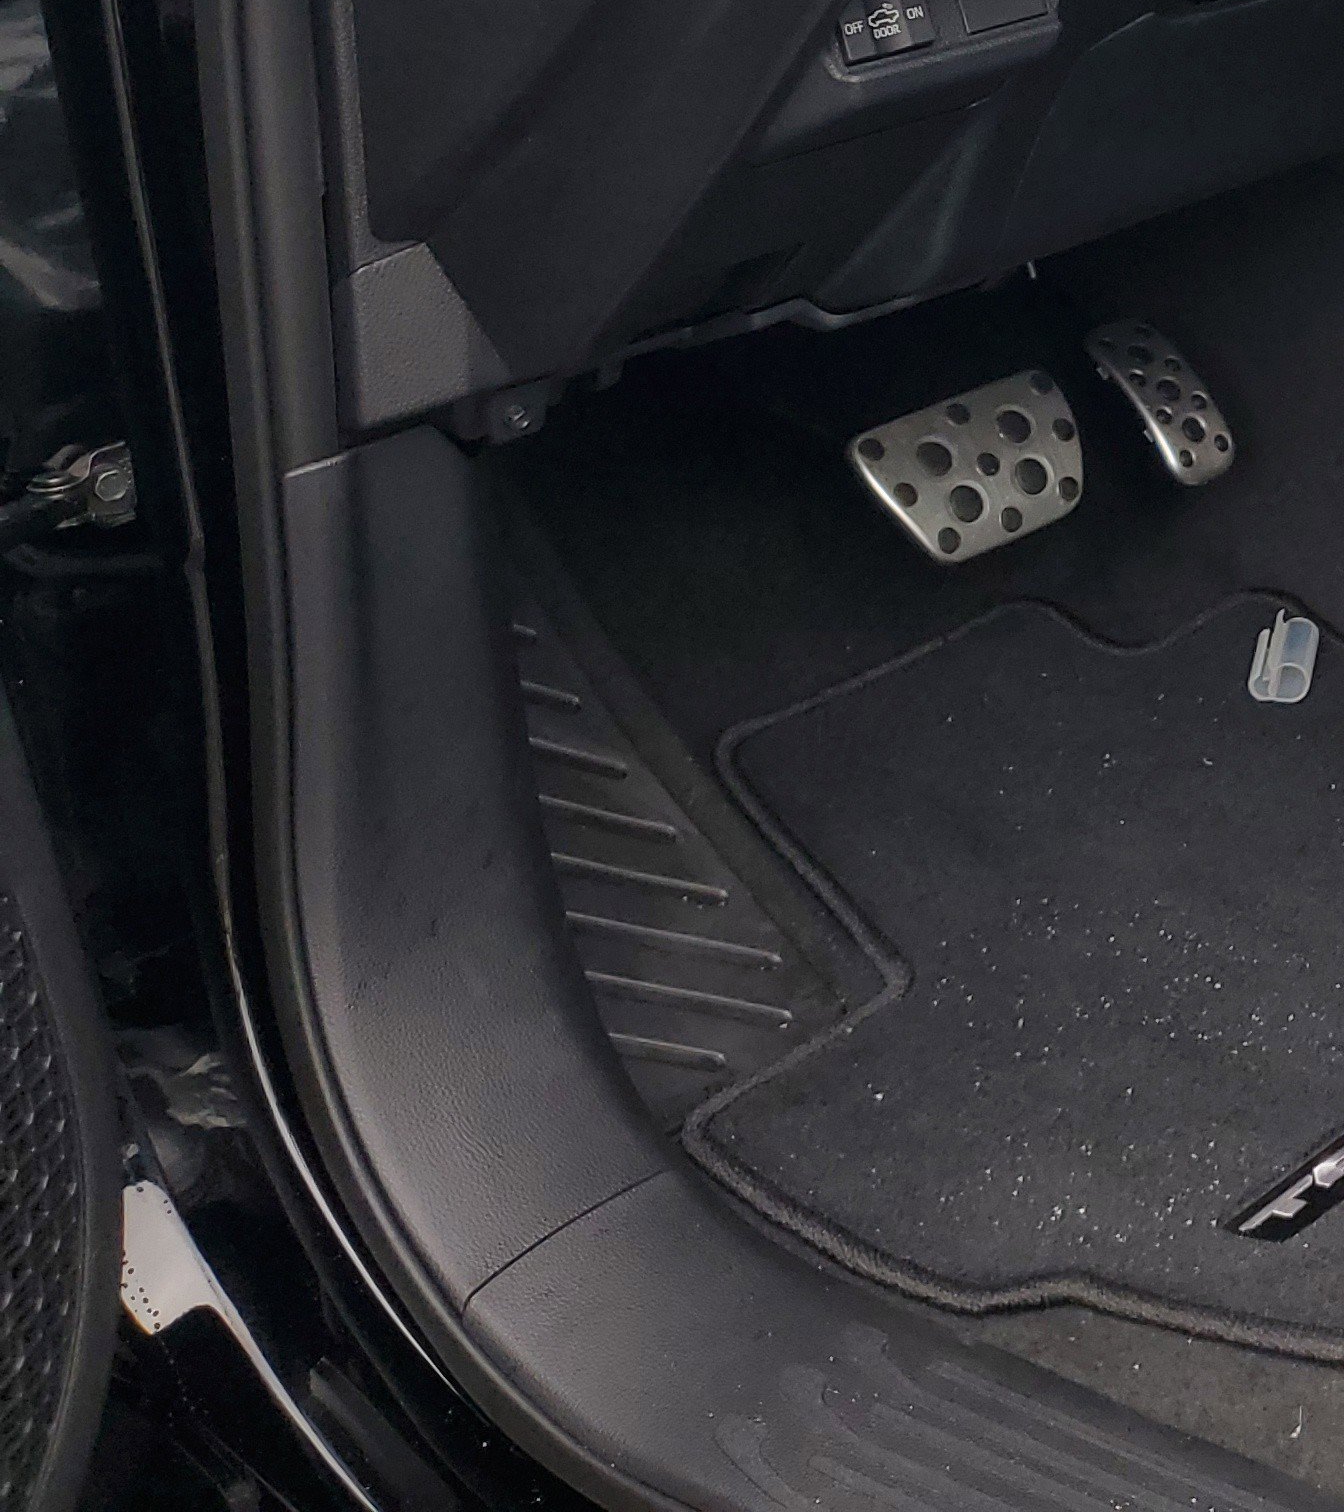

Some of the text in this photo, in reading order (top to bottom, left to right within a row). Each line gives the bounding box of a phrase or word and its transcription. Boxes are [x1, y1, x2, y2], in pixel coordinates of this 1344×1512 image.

[906, 5, 924, 20] ON
[844, 20, 863, 36] OFF
[873, 24, 902, 39] DOOR
